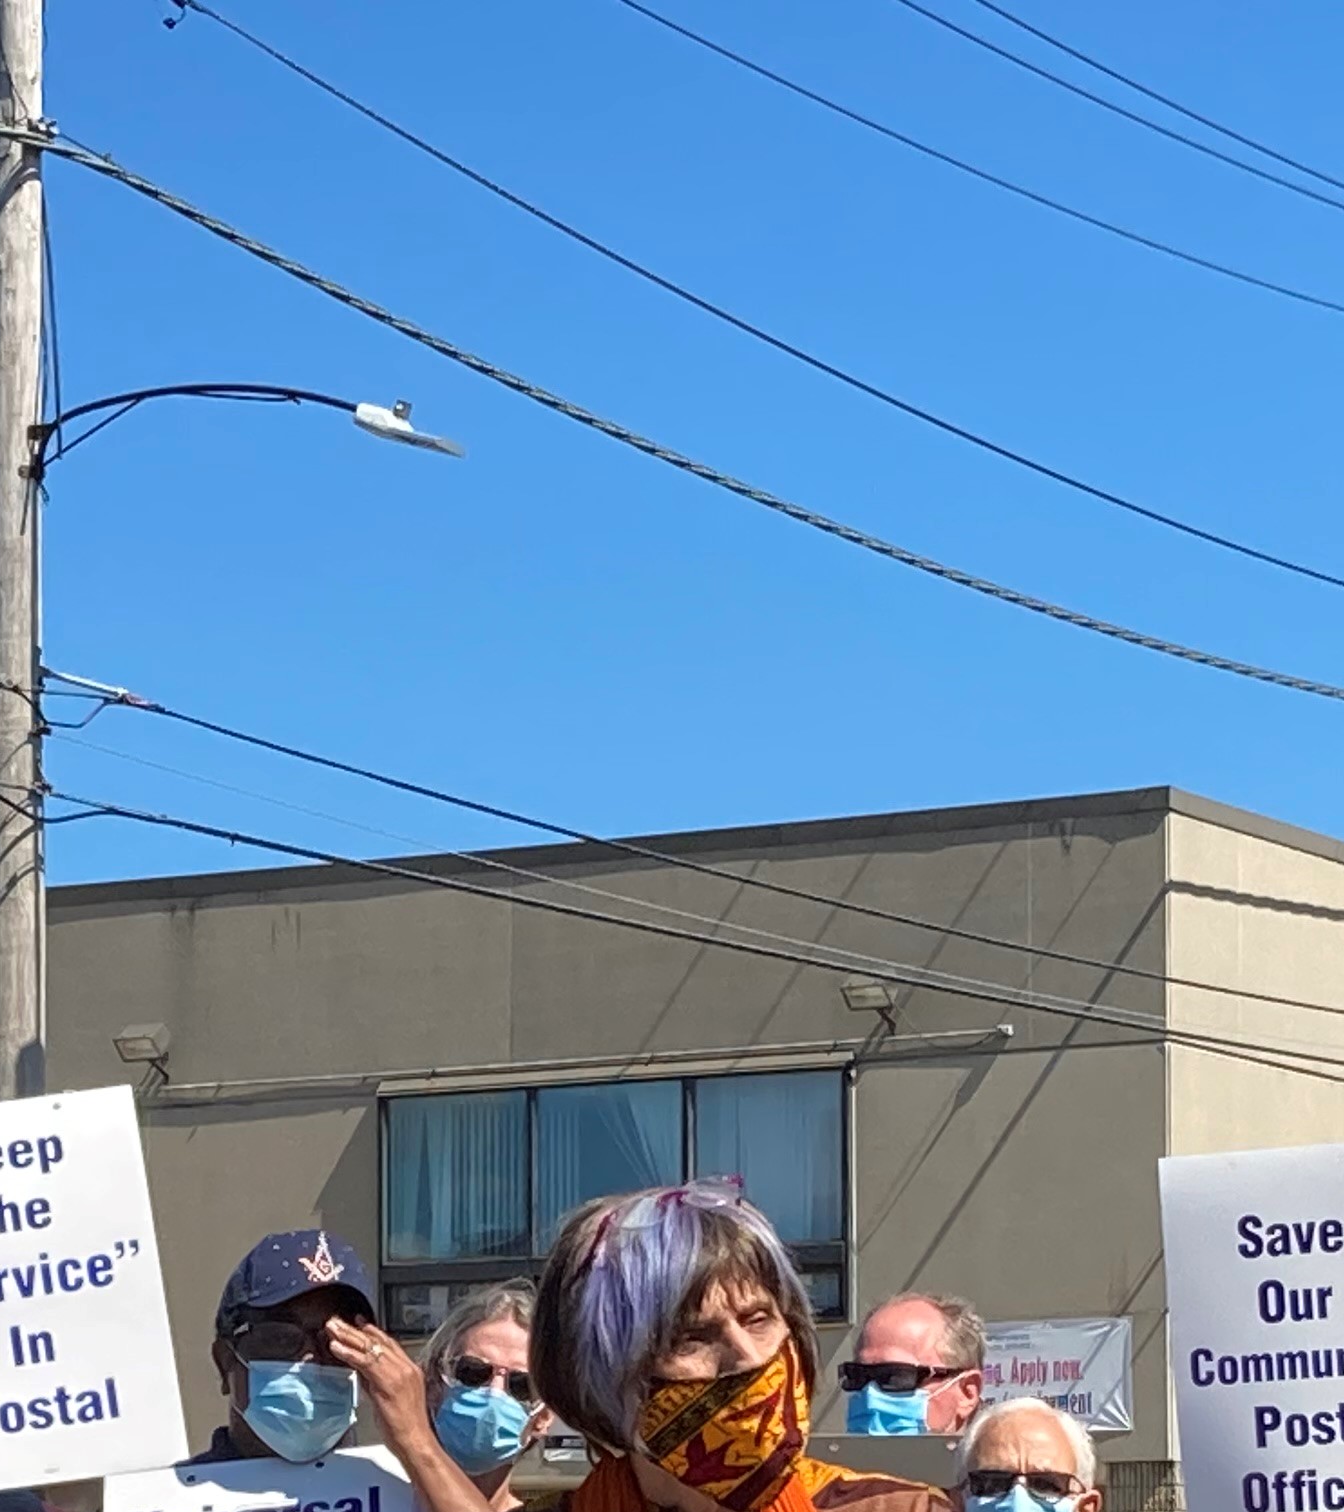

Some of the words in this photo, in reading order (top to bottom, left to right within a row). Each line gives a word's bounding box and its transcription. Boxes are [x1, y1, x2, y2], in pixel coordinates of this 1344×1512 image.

[1236, 1214, 1344, 1259] Save
[1256, 1279, 1333, 1324] Our
[10, 1325, 56, 1367] In
[1010, 1355, 1048, 1387] Apply
